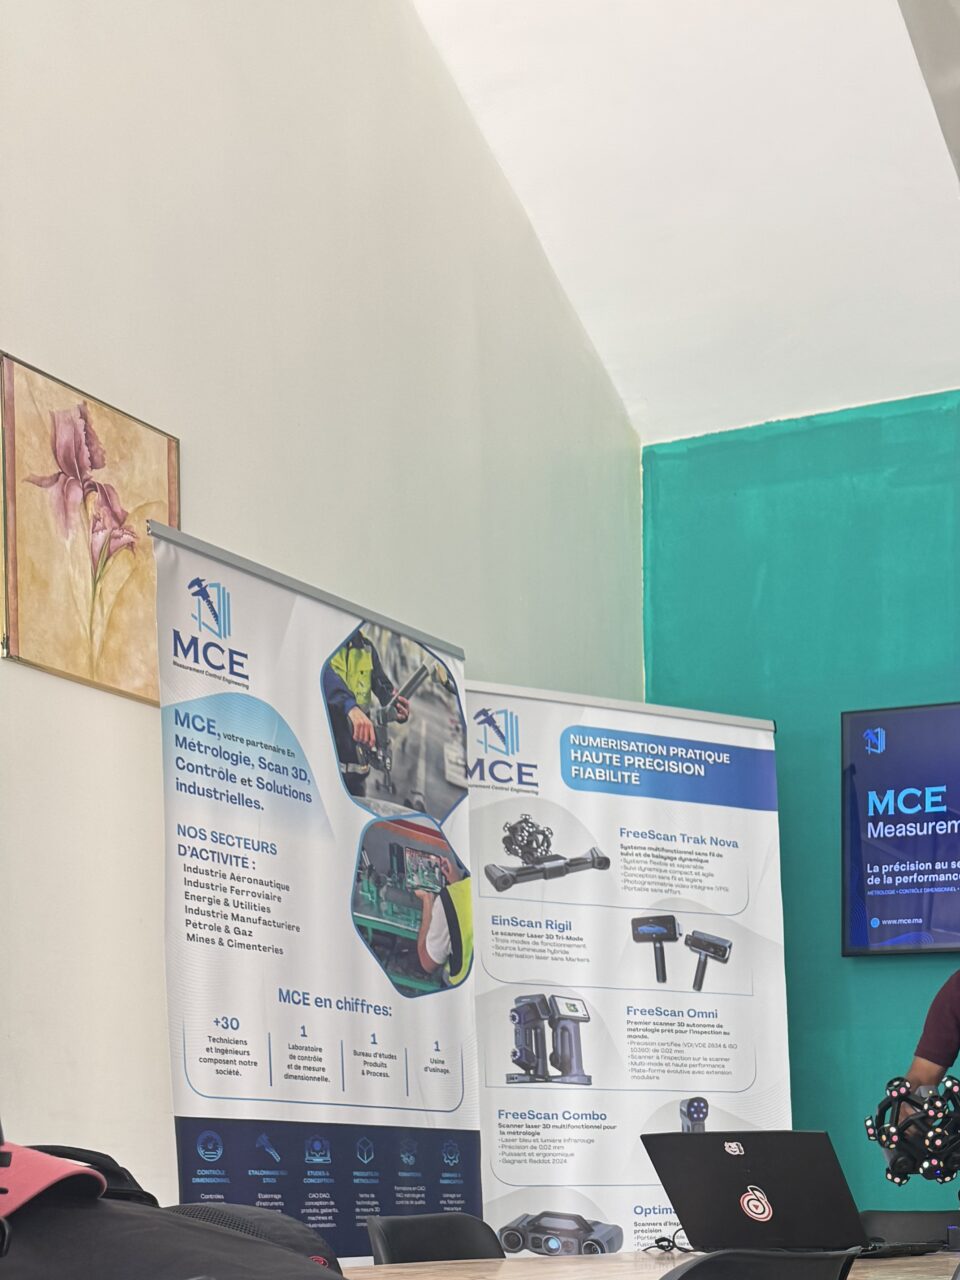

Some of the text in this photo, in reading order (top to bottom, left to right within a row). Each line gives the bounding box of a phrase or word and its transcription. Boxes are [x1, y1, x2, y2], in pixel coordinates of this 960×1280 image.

[172, 628, 249, 681] MCE
[174, 708, 296, 758] MCE, votre partenaire En
[174, 734, 311, 785] Métrologie, Scan 3D,
[570, 749, 621, 767] HAUTE
[669, 746, 731, 765] PRATIQUE
[175, 756, 313, 803] Contrôle et Solutions
[466, 757, 539, 788] MCE
[175, 777, 264, 811] industrielles.
[867, 785, 947, 817] MCE
[177, 823, 278, 856] NOS SECTEURS
[619, 827, 739, 849] FreeScan Trak Nova
[183, 863, 227, 880] Industrie
[866, 863, 880, 874] La
[881, 861, 932, 875] précision
[934, 861, 948, 870] au
[866, 875, 881, 885] de
[883, 875, 893, 884] la
[183, 877, 282, 903] Industrie Ferroviaire
[184, 905, 229, 921] Industrie
[223, 897, 230, 907] &
[232, 900, 271, 914] Utilities
[491, 915, 572, 933] EinScan Rigil
[881, 917, 923, 925] www.mce.ma
[224, 925, 231, 935] &
[233, 927, 253, 937] Gaz
[555, 934, 584, 942] Tri-Mode
[186, 932, 284, 955] Mines & Cimenteries
[278, 988, 393, 1017] MCE en chiffres:
[626, 1006, 718, 1019] FreeScan Omni
[213, 1016, 240, 1031] +30
[300, 1025, 308, 1038] 1
[370, 1032, 378, 1045] 1
[207, 1035, 248, 1047] Techniciens
[287, 1043, 323, 1053] Laboratoire
[434, 1040, 441, 1052] 1
[205, 1046, 213, 1054] et
[353, 1049, 372, 1058] Bureau
[198, 1057, 237, 1066] composent
[363, 1060, 388, 1069] Produits
[497, 1109, 607, 1121] FreeScan Combo
[633, 1205, 677, 1218] Optim
[663, 1220, 682, 1228] d'Insp
